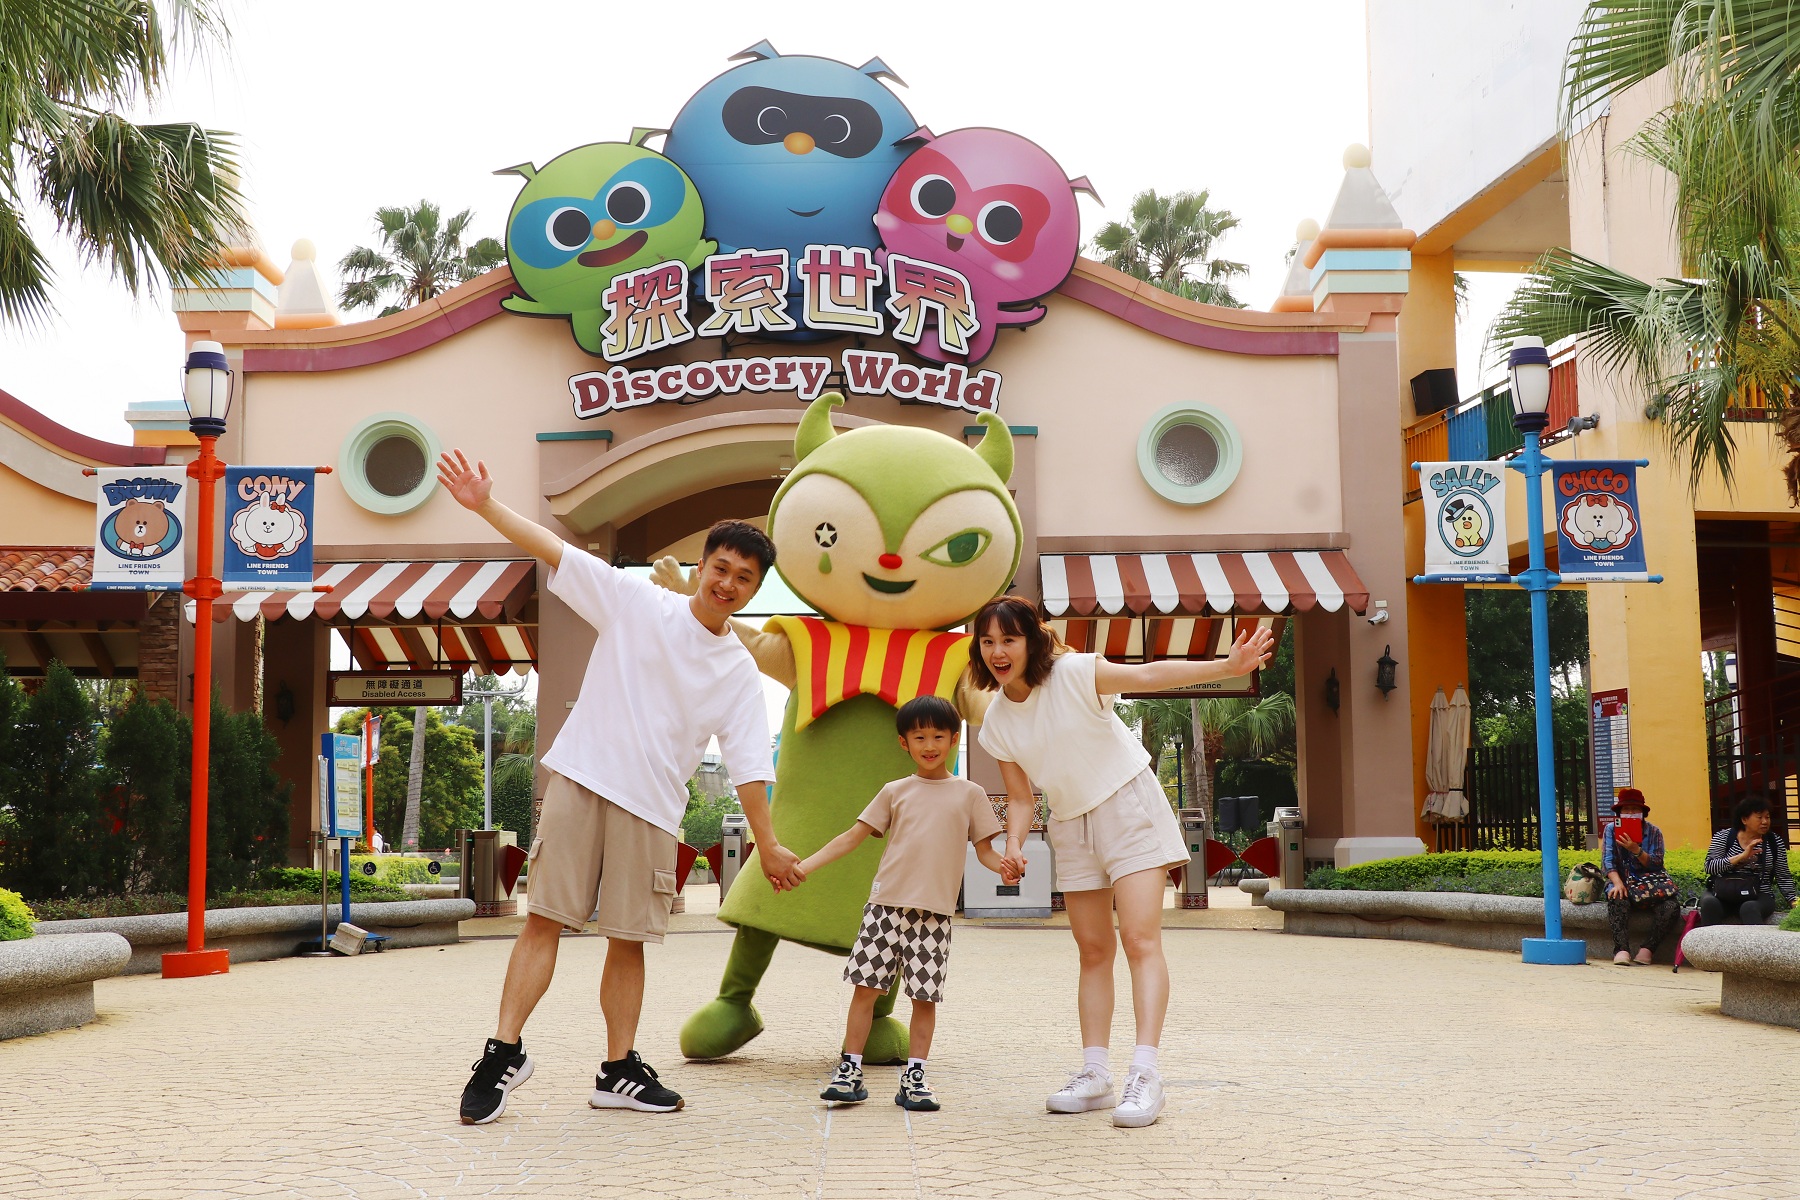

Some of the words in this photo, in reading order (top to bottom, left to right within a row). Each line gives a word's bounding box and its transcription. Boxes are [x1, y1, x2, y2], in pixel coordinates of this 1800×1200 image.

[604, 247, 975, 358] 探索世界
[573, 359, 827, 413] Discovery
[846, 354, 997, 410] World
[102, 477, 182, 506] BROWN
[237, 475, 307, 502] CONY
[1430, 465, 1500, 498] SALLY
[1558, 468, 1629, 497] CHOCO
[366, 680, 422, 689] 無障礙通道
